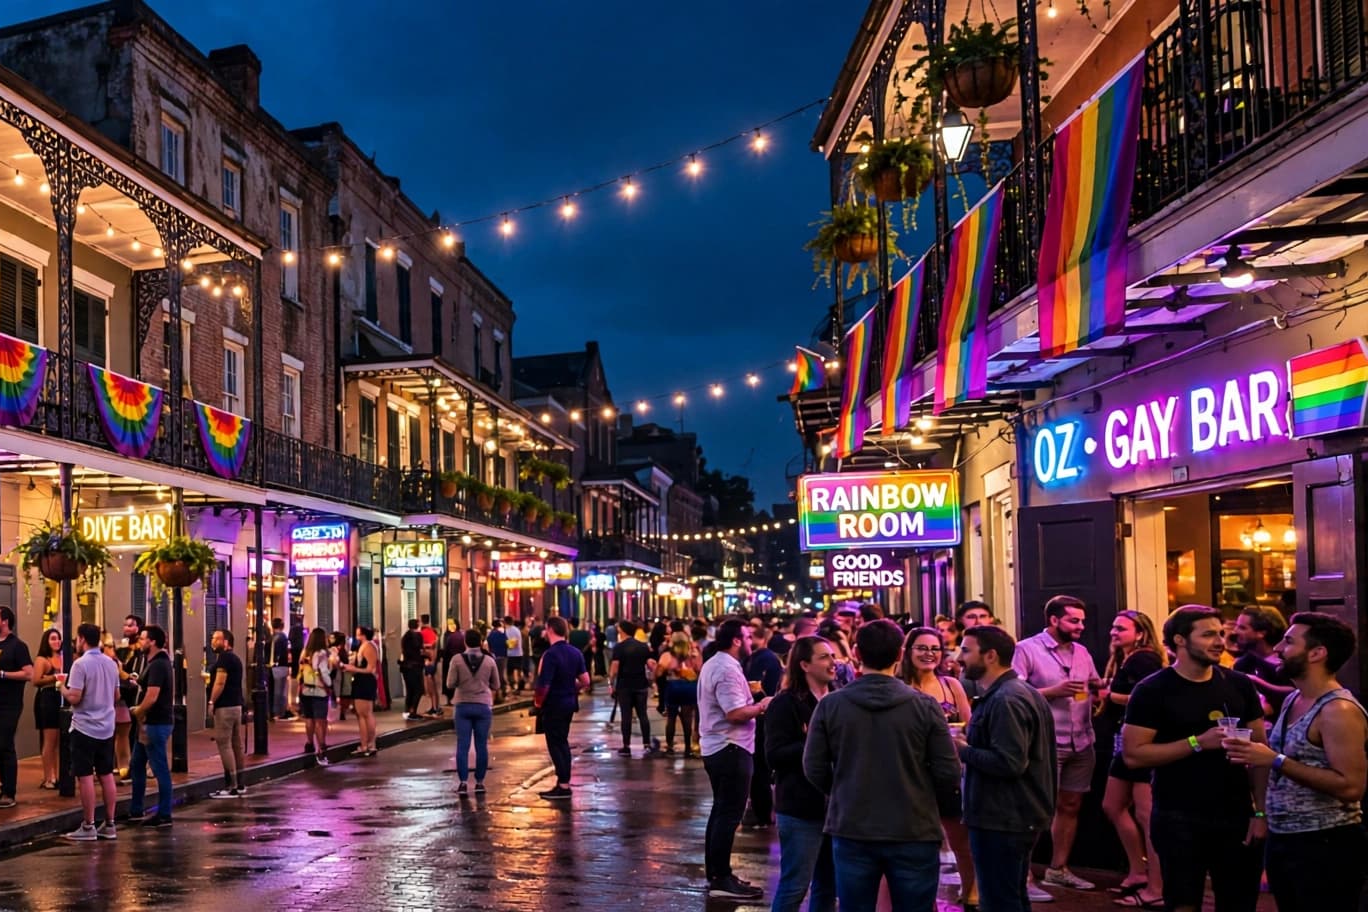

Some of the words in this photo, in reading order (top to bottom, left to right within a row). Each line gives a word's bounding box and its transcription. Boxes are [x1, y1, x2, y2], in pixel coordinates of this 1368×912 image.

[1034, 421, 1079, 483] OZ
[1105, 396, 1178, 468] GAY
[1190, 370, 1282, 453] BAR
[811, 482, 947, 512] RAINBOW
[83, 516, 123, 542] DIVE
[128, 514, 166, 540] BAR
[839, 511, 924, 538] ROOM
[832, 554, 882, 570] GOOD
[833, 570, 904, 587] FRIENDS
